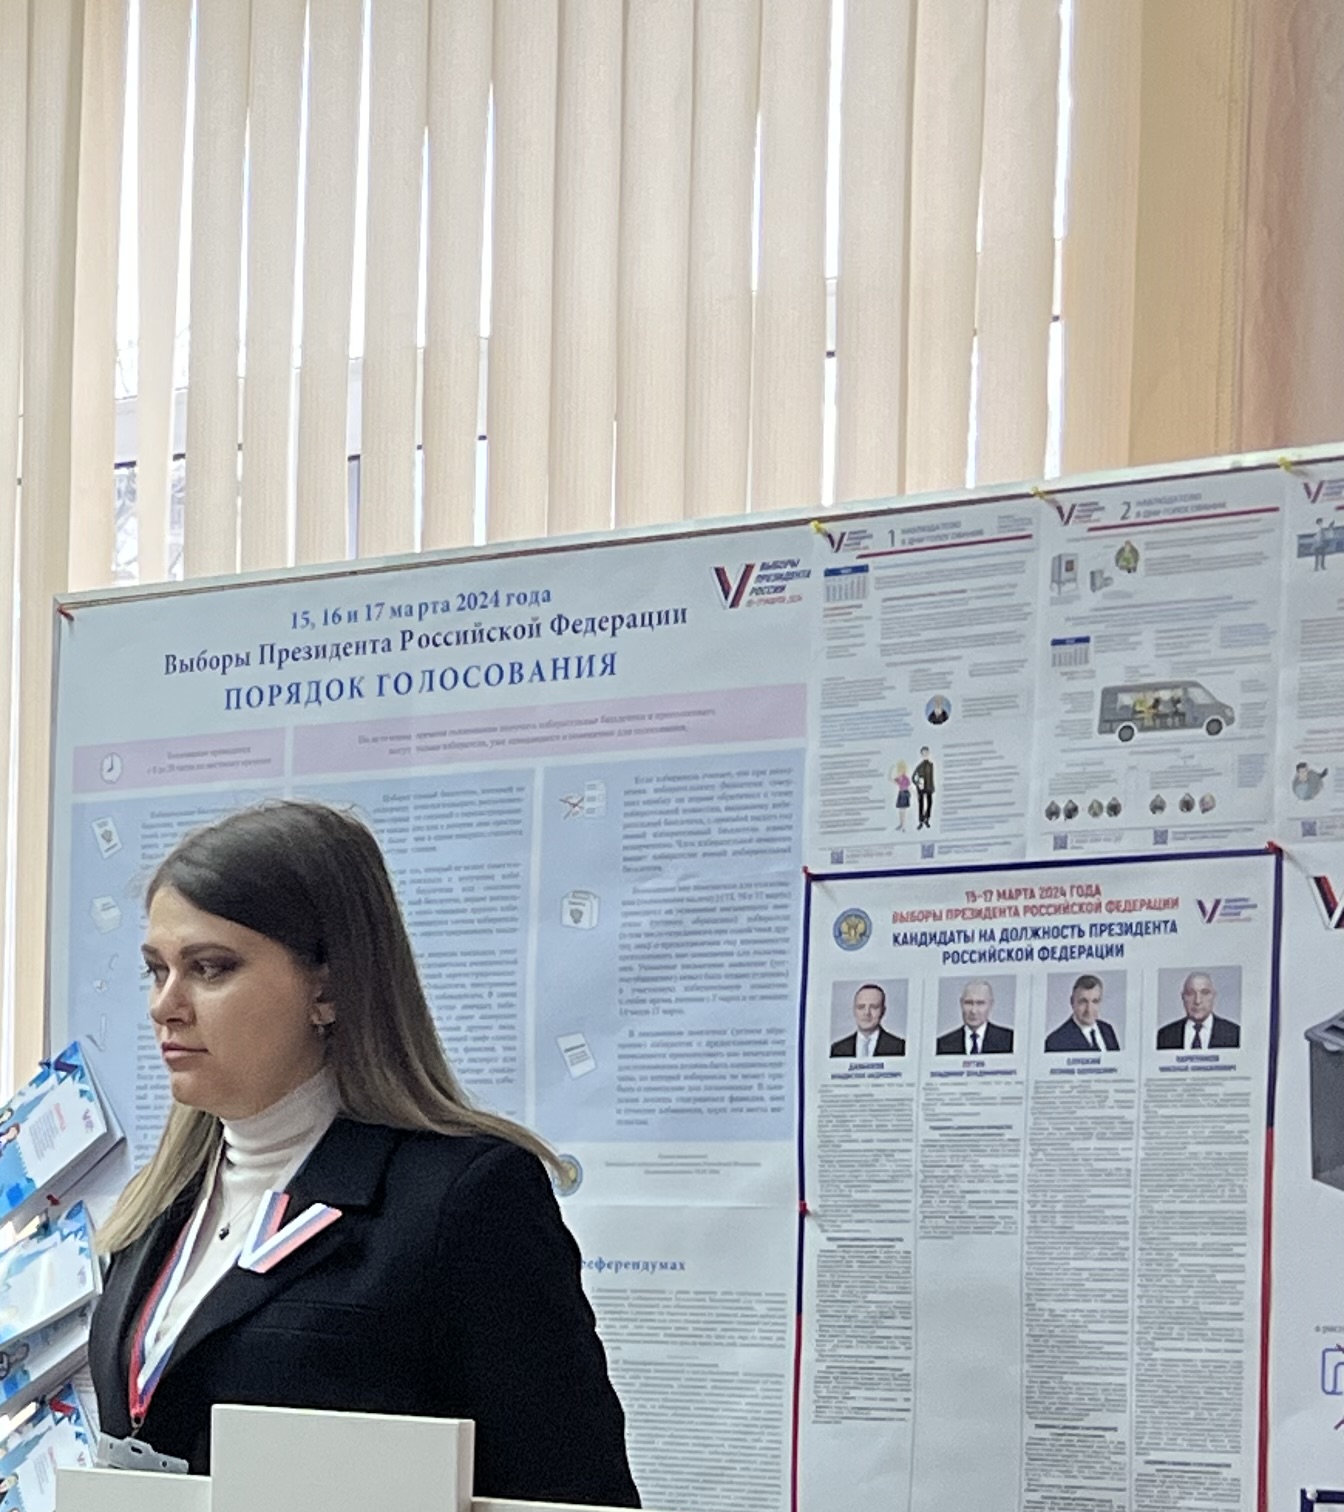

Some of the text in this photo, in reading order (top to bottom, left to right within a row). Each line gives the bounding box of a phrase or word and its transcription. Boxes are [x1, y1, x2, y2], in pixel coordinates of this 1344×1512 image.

[291, 589, 552, 630] 15, 16 и 17 марта 2024 года
[164, 607, 688, 675] Выборы Президента Российской Федерации
[224, 651, 618, 710] ПОРЯДОК ГОЛОСОВАНИЯ
[996, 887, 1036, 902] МАРТА
[1039, 885, 1067, 900] 2024
[1069, 883, 1102, 899] ГОДА
[892, 897, 1180, 925] ВЫБОРЫ ПРЕЗИДЕНТА РОССИЙСКОЙ ФЕДЕРАЦИИ
[892, 918, 1179, 948] КАНДИДАТЫ НА ДОЛЖНОСТЬ ПРЕЗИДЕНТА
[942, 943, 1125, 966] РОССИЙСКОЙ ФЕДЕРАЦИИ
[581, 1256, 687, 1275] еферендумах
